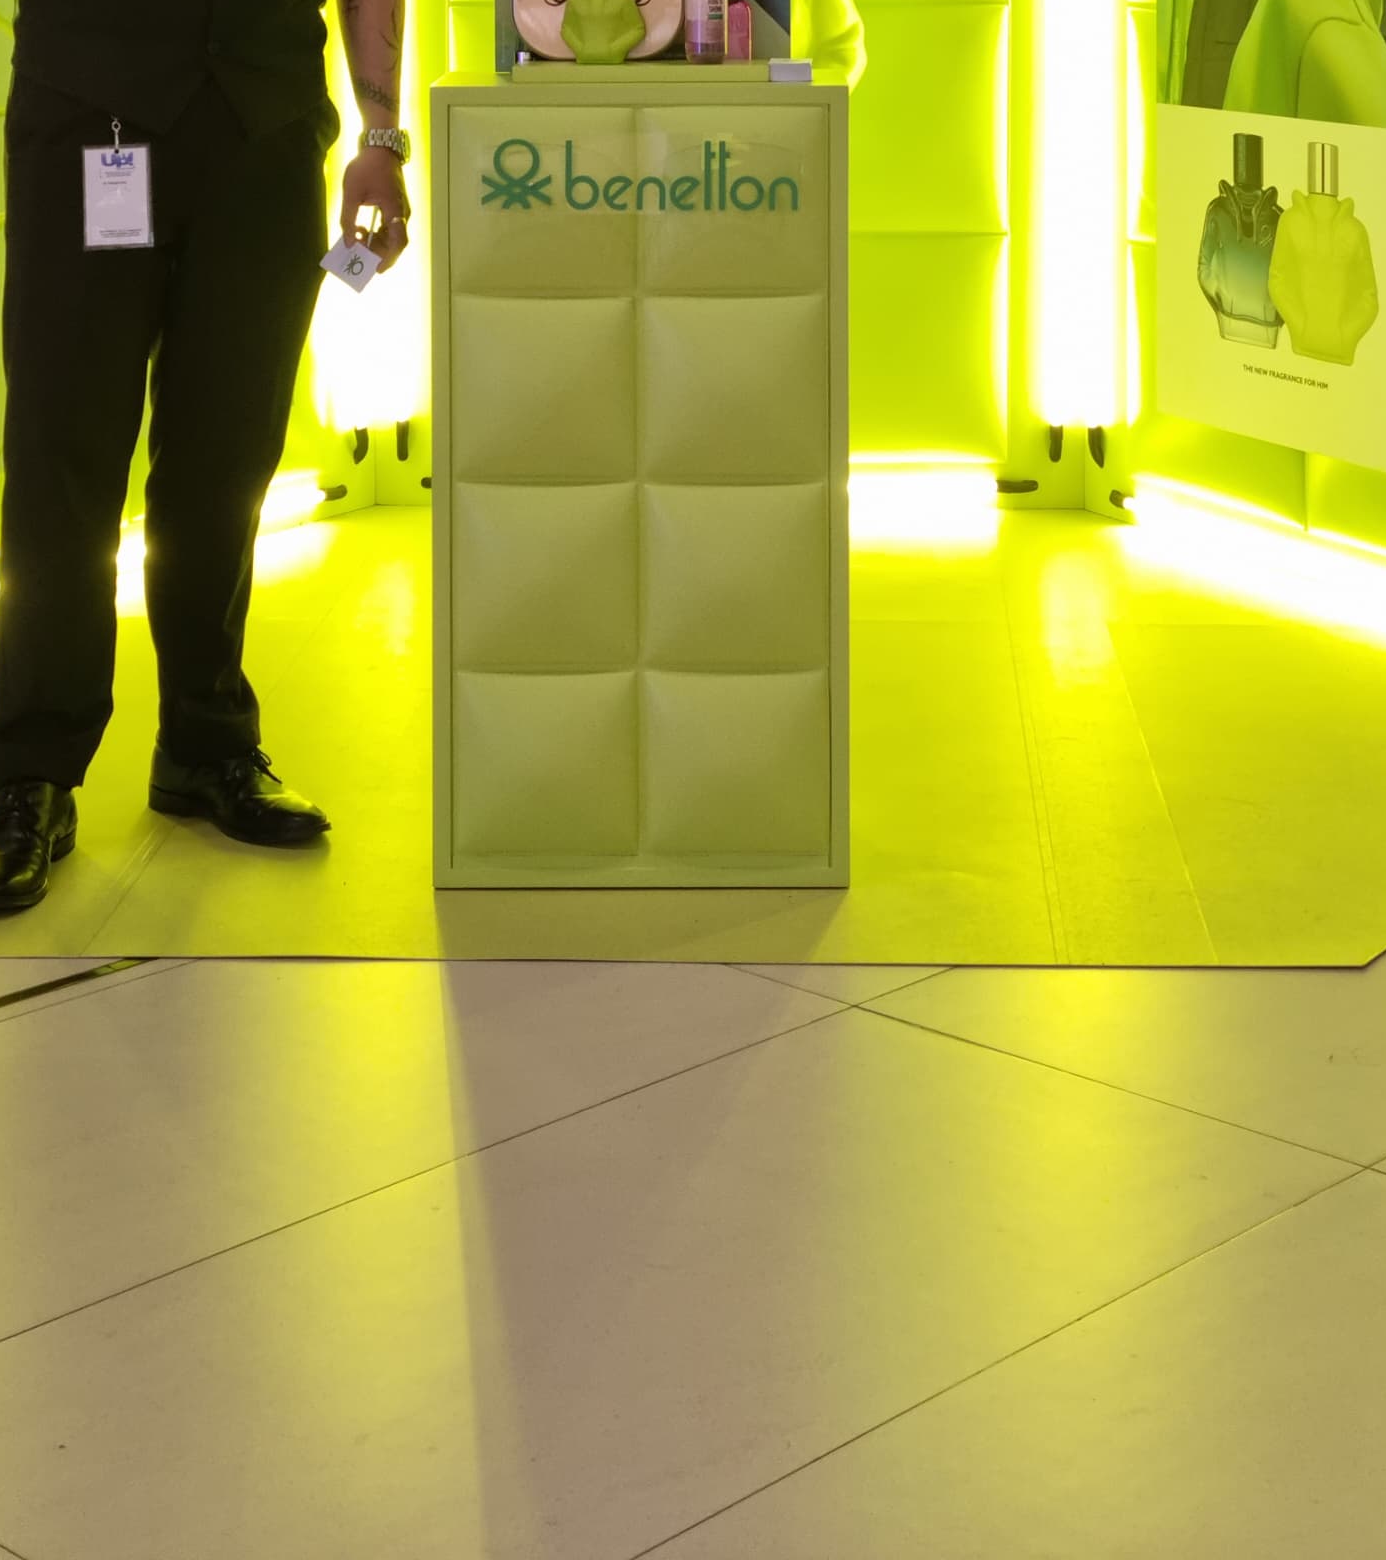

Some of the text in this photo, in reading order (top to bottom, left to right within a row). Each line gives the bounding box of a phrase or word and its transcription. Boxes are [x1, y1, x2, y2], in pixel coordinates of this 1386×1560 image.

[565, 140, 798, 210] benetton
[1243, 363, 1329, 390] THE NEW FRAGRANCE FOR HIM
